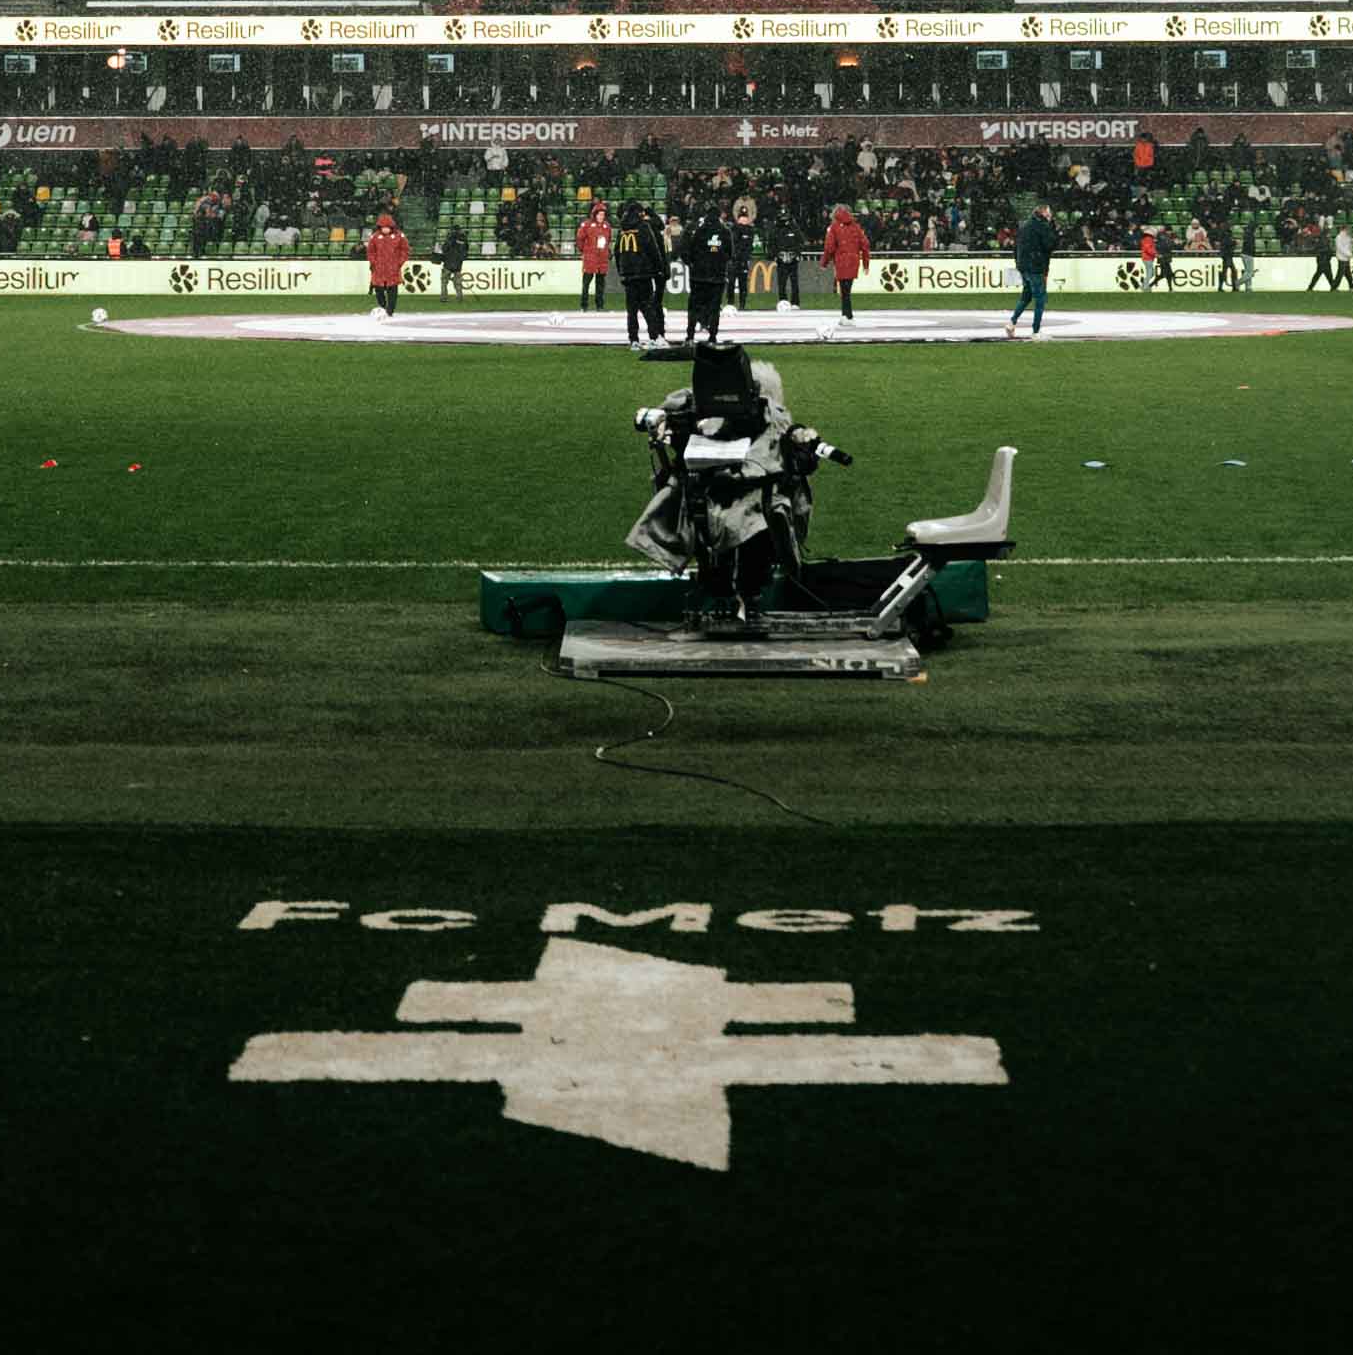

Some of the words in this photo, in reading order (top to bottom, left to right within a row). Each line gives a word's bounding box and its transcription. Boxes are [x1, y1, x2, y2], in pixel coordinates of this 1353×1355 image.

[328, 20, 416, 39] Resilium
[761, 18, 848, 37] Resilium
[1194, 16, 1281, 35] Resilium
[16, 124, 76, 143] uem
[442, 122, 579, 142] INTERSPORT
[761, 124, 779, 138] Fc
[782, 124, 820, 138] Metz
[1002, 120, 1139, 140] INTERSPORT
[460, 267, 546, 290] esiliu
[918, 265, 1019, 288] Resiliu
[238, 899, 478, 932] Fc
[539, 901, 1042, 934] Metz
